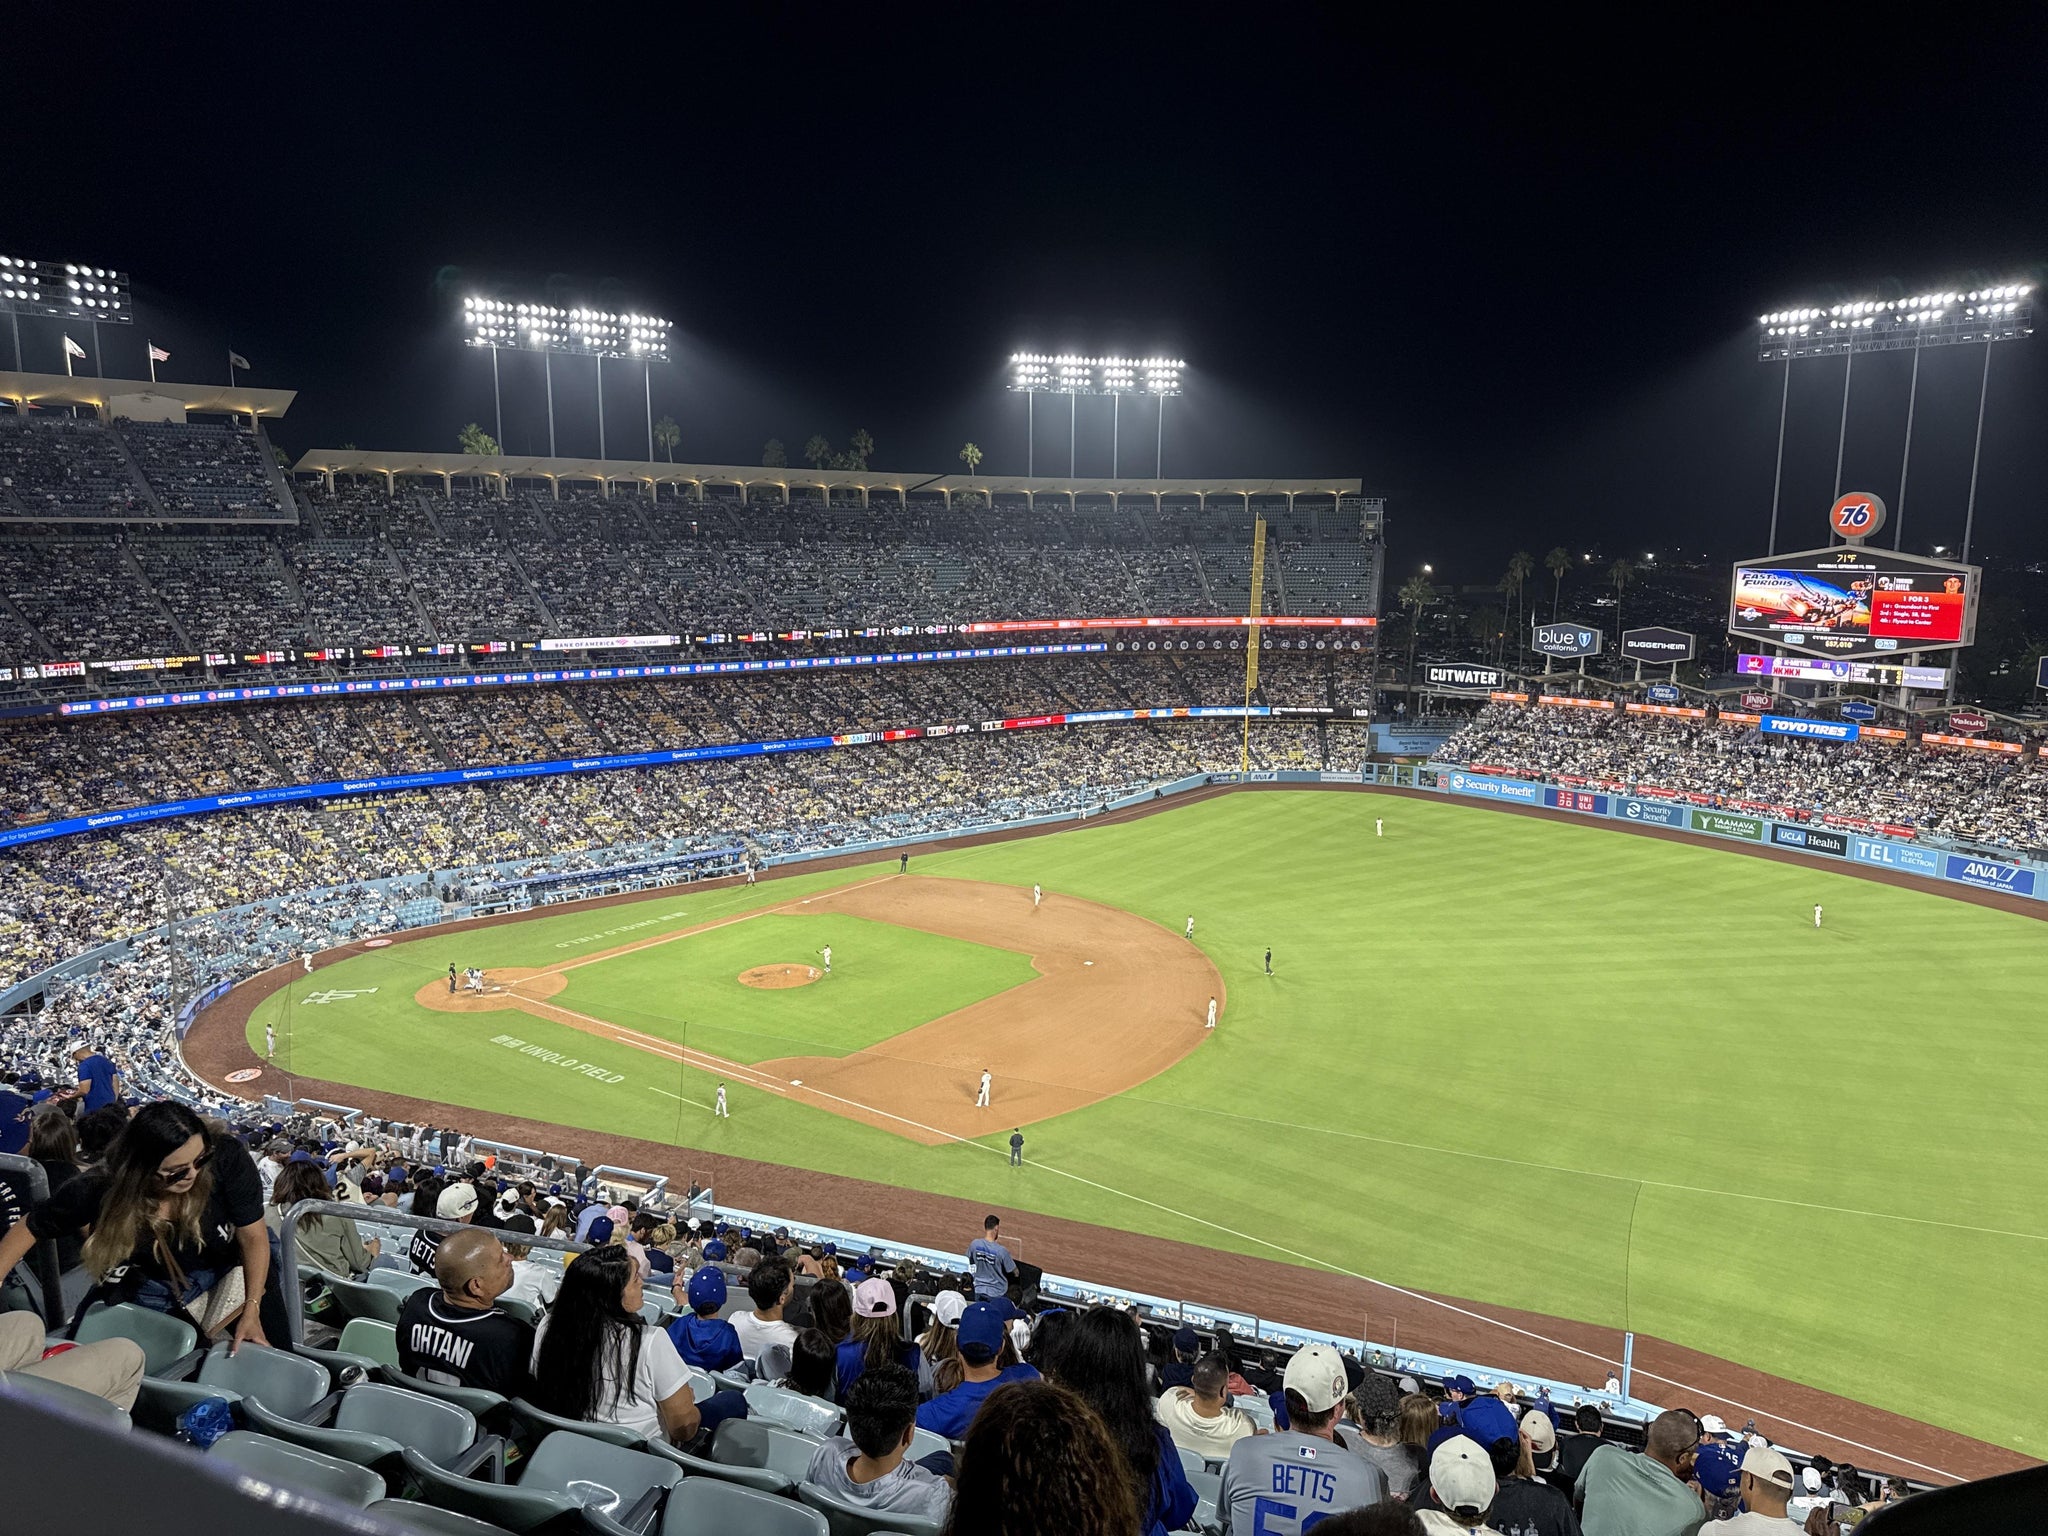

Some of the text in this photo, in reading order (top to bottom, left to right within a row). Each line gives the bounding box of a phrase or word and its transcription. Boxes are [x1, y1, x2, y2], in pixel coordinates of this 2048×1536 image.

[1839, 503, 1870, 527] 76
[1538, 629, 1575, 645] blue
[1544, 643, 1578, 652] california
[1628, 640, 1686, 650] GUGGENHEIM
[1430, 668, 1497, 685] CUTWATER
[1746, 694, 1768, 705] JINRO
[1952, 717, 1986, 727] Yakult
[1771, 720, 1848, 737] TOYO TIRES
[572, 760, 598, 768] Spectrum
[462, 770, 492, 778] Spectrum
[343, 781, 375, 792] Spectrum
[1439, 776, 1448, 786] 76
[1466, 779, 1534, 798] Security Benefit
[218, 795, 250, 806] Spectrum
[1580, 794, 1592, 802] UNI
[1578, 802, 1592, 810] QLO
[1643, 804, 1672, 816] Security
[88, 814, 120, 826] Spectrum
[1643, 812, 1668, 822] Benefit
[18, 832, 27, 840] big
[1780, 831, 1841, 850] UCLA Health
[1857, 842, 1894, 863] TEL
[1900, 850, 1923, 860] TOKYO
[1900, 857, 1935, 868] ELECTRON
[1963, 862, 1999, 880] ANA
[1962, 875, 1990, 886] Inspiration
[1996, 882, 2014, 890] JAPAN
[520, 1044, 626, 1084] UNIQLO FIELD
[411, 1323, 475, 1369] OHTANI
[1272, 1464, 1336, 1504] BETTS
